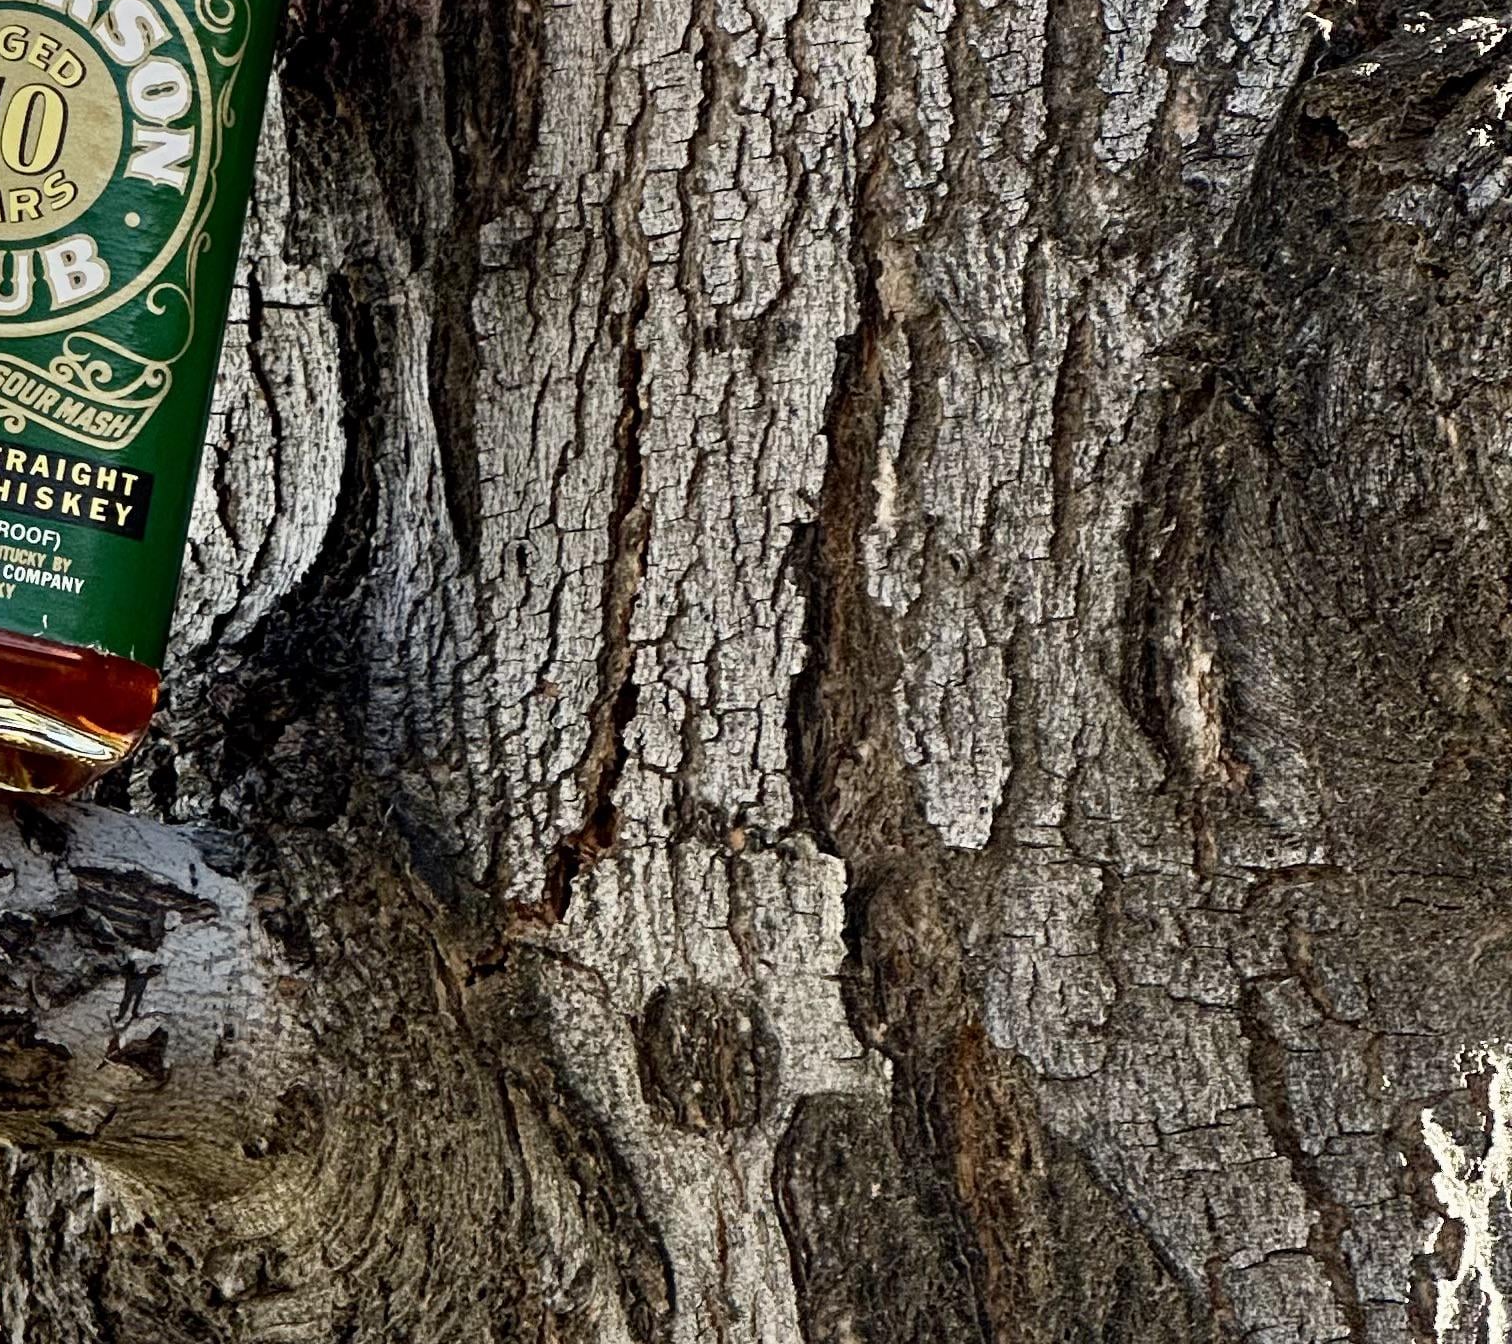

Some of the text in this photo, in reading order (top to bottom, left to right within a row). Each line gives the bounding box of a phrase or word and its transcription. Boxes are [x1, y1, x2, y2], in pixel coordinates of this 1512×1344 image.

[53, 399, 136, 439] MASH
[53, 556, 72, 573] BY
[2, 565, 85, 594] COMPANY
